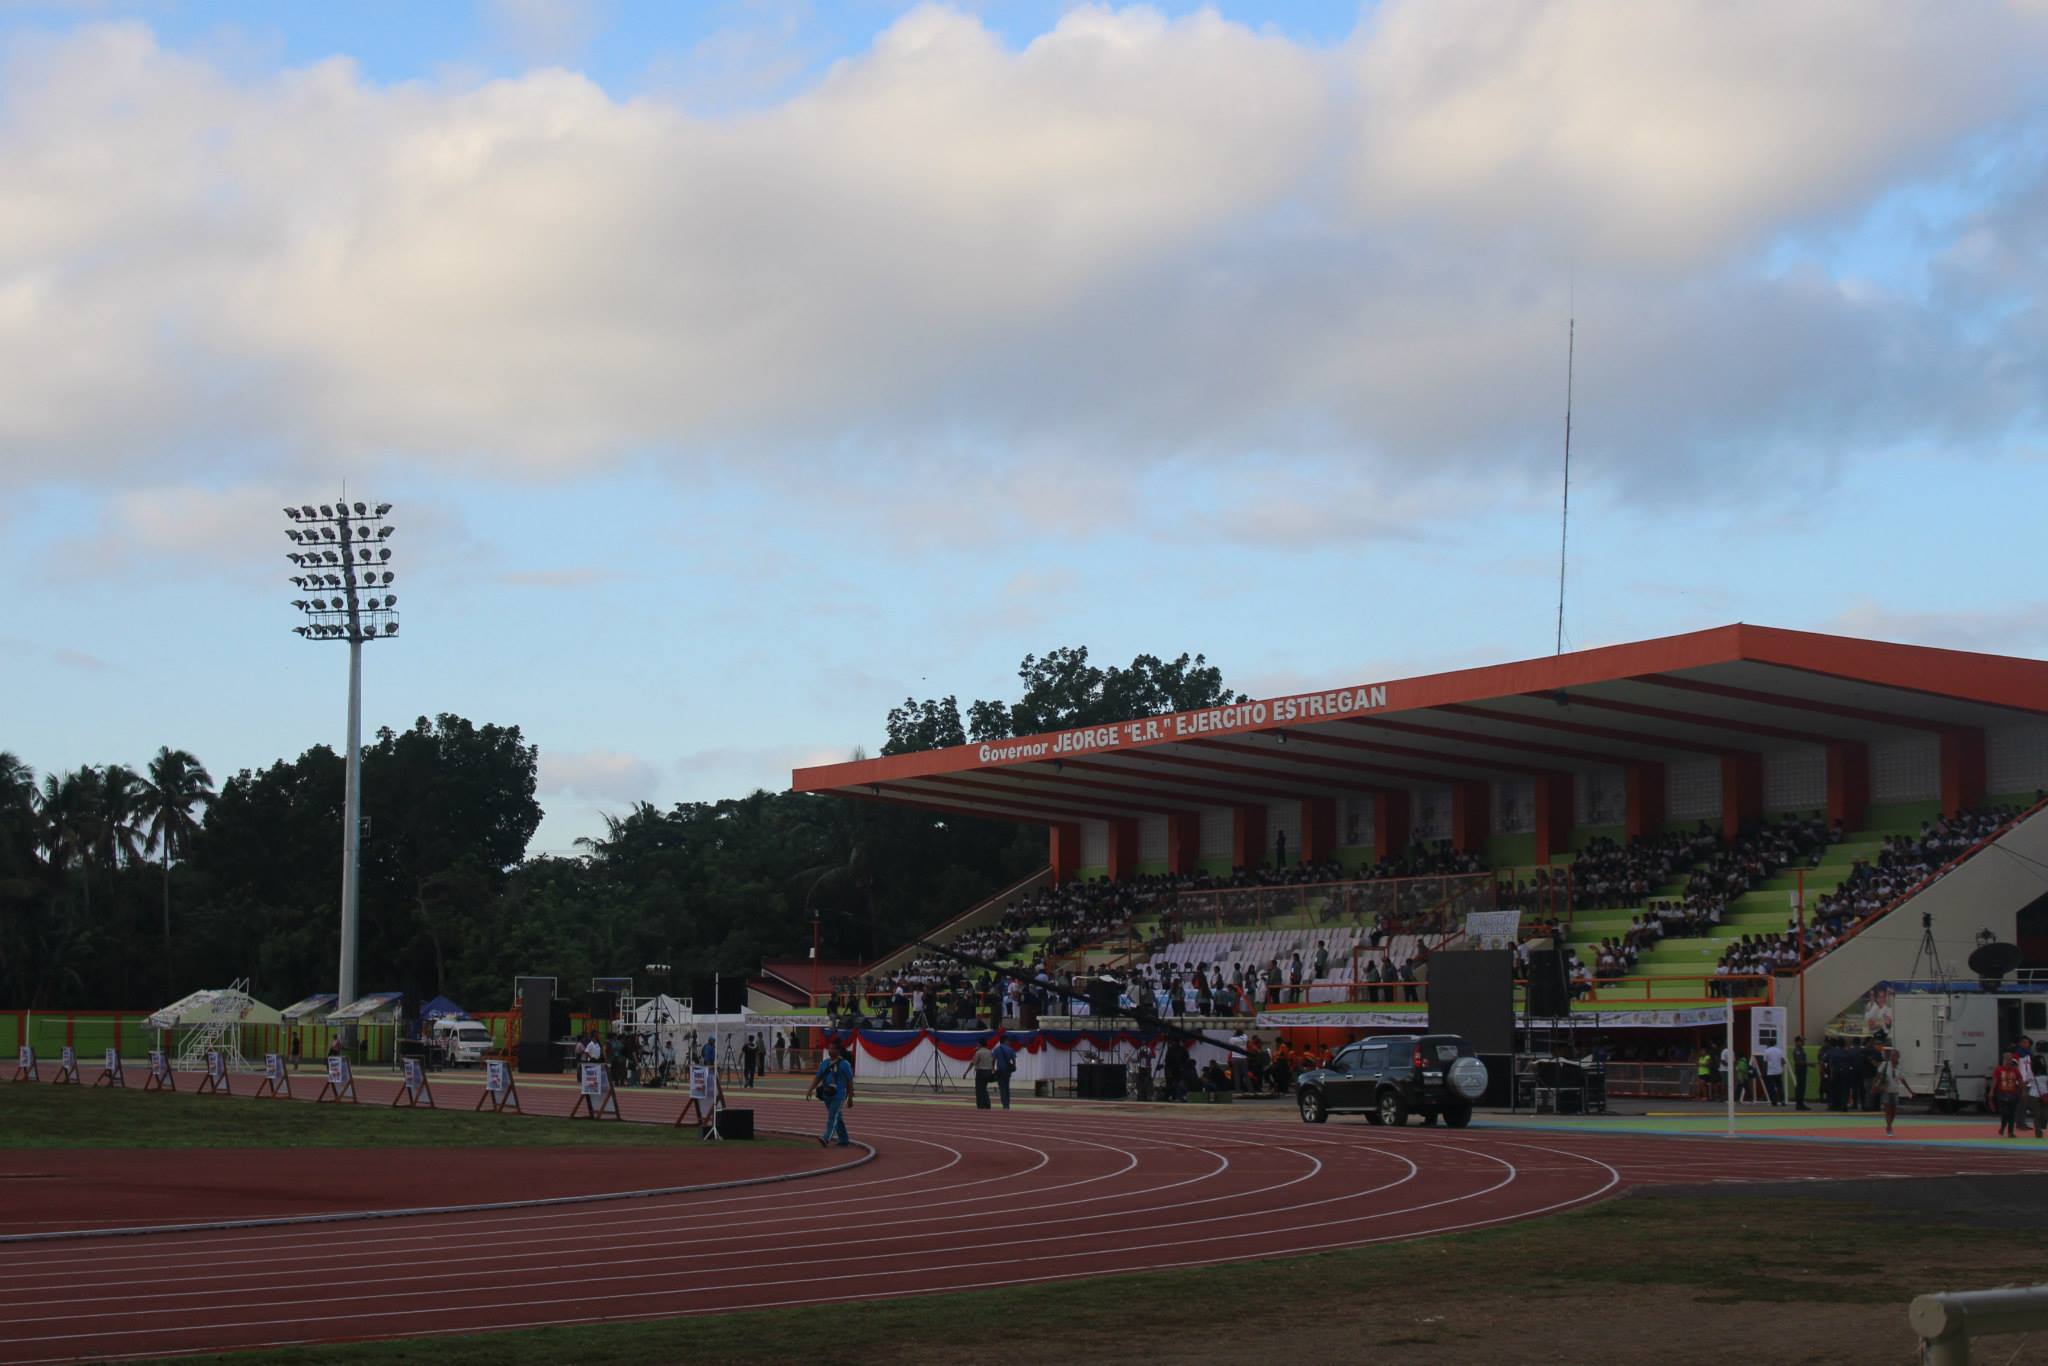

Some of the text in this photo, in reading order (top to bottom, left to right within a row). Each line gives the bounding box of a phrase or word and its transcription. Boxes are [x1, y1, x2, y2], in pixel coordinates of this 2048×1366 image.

[979, 744, 1049, 762] Governor
[1053, 727, 1120, 753] JEORGE
[1176, 703, 1267, 736] EJERCITO
[1273, 686, 1386, 721] ESTREGAN
